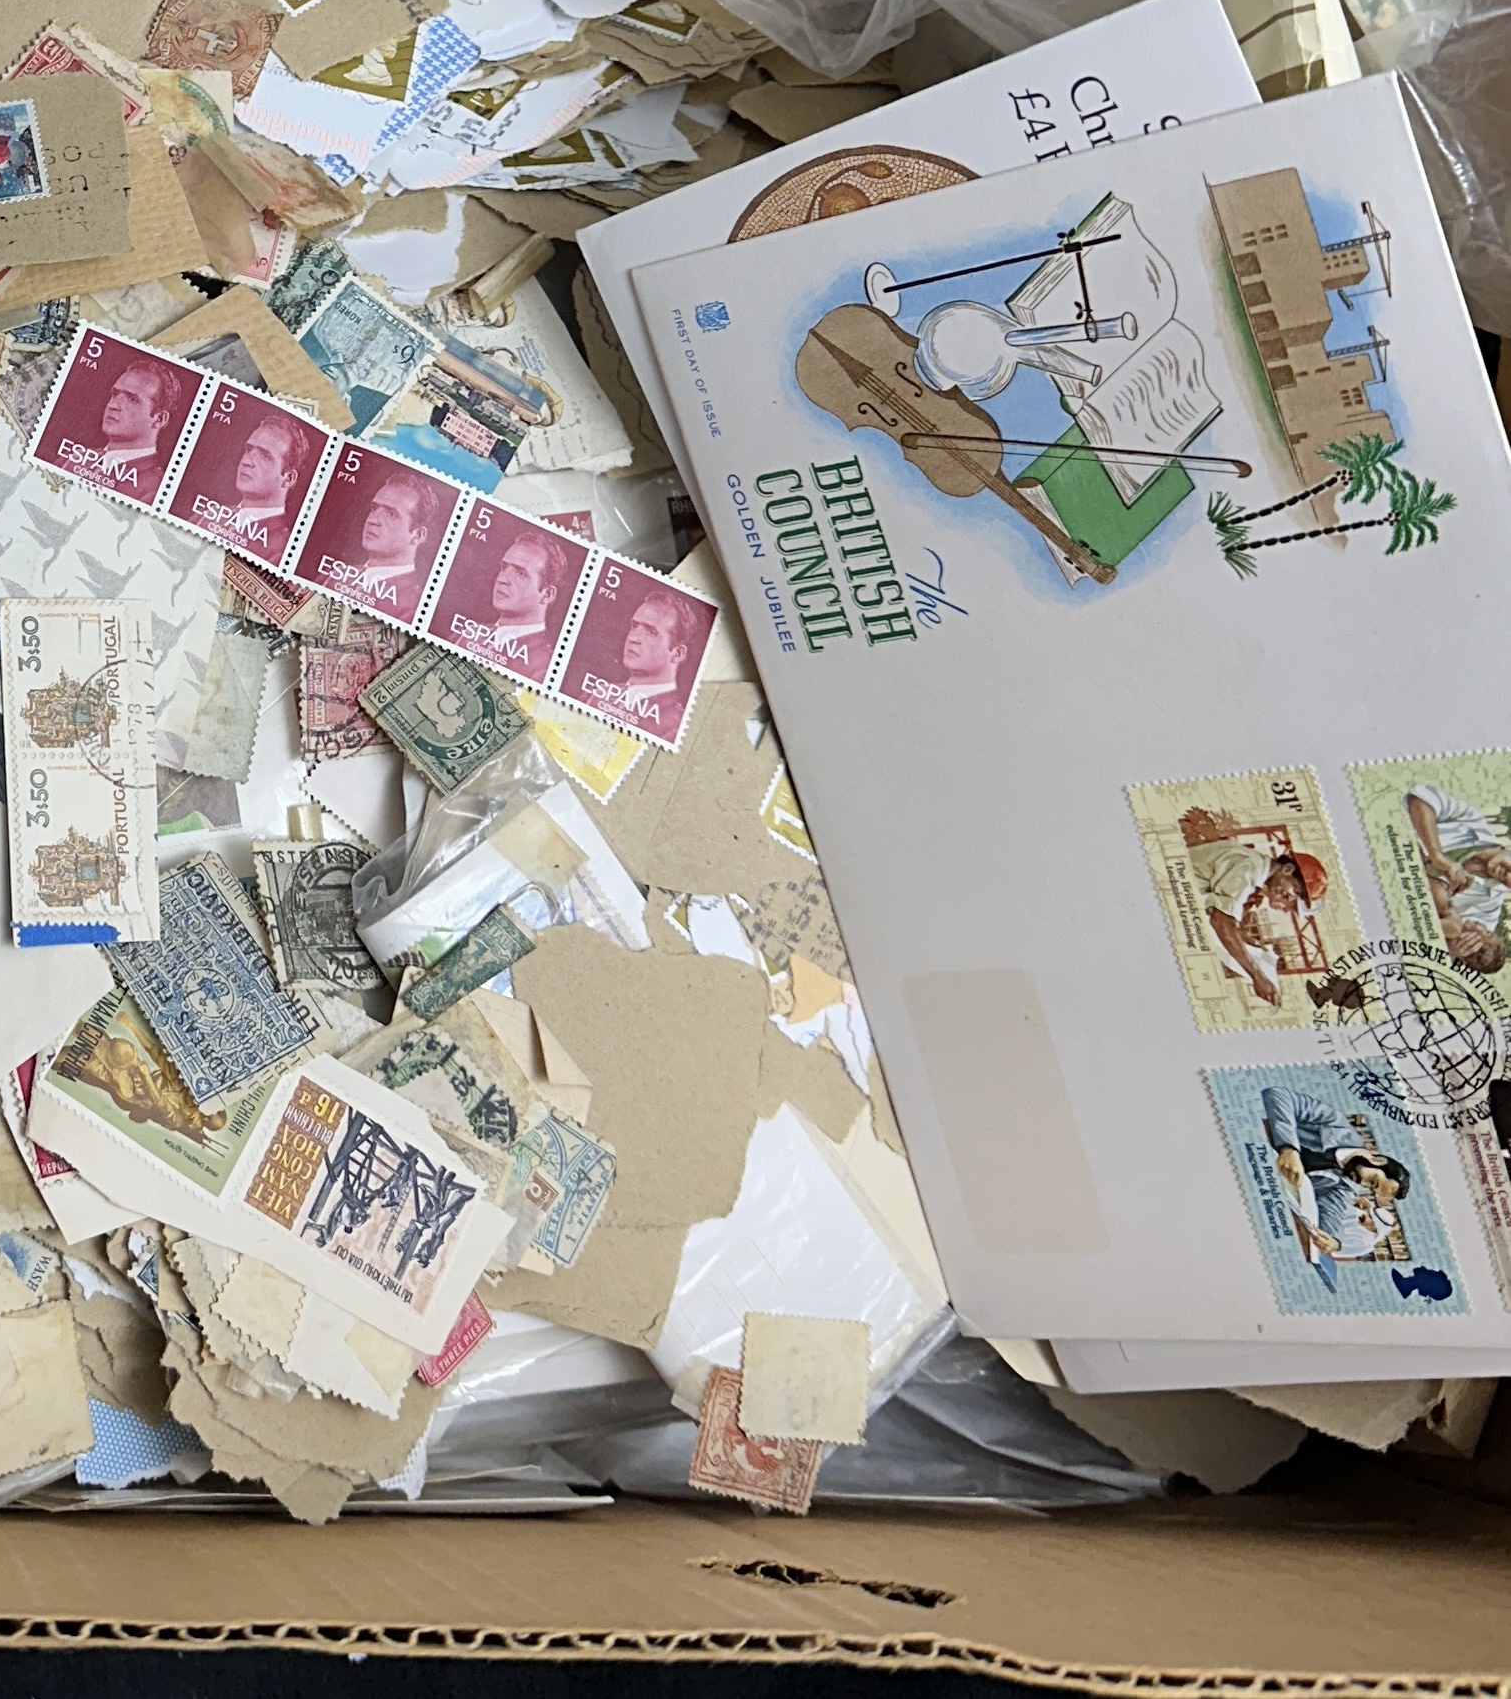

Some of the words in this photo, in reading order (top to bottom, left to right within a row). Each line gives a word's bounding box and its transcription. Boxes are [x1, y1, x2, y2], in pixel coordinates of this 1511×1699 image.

[87, 336, 106, 358] 5
[671, 307, 691, 345] FIRST
[684, 349, 700, 374] DAY
[694, 377, 708, 396] OF
[701, 399, 722, 439] ISSUE
[219, 390, 239, 413] 5
[343, 450, 364, 472] 5
[475, 506, 492, 531] 5
[726, 473, 766, 560] GOLDEN
[760, 575, 798, 654] JUBILEE
[754, 467, 854, 654] COUNCIL
[810, 453, 918, 648] BRITISH
[604, 565, 623, 589] 5
[1401, 938, 1450, 968] ISSUE
